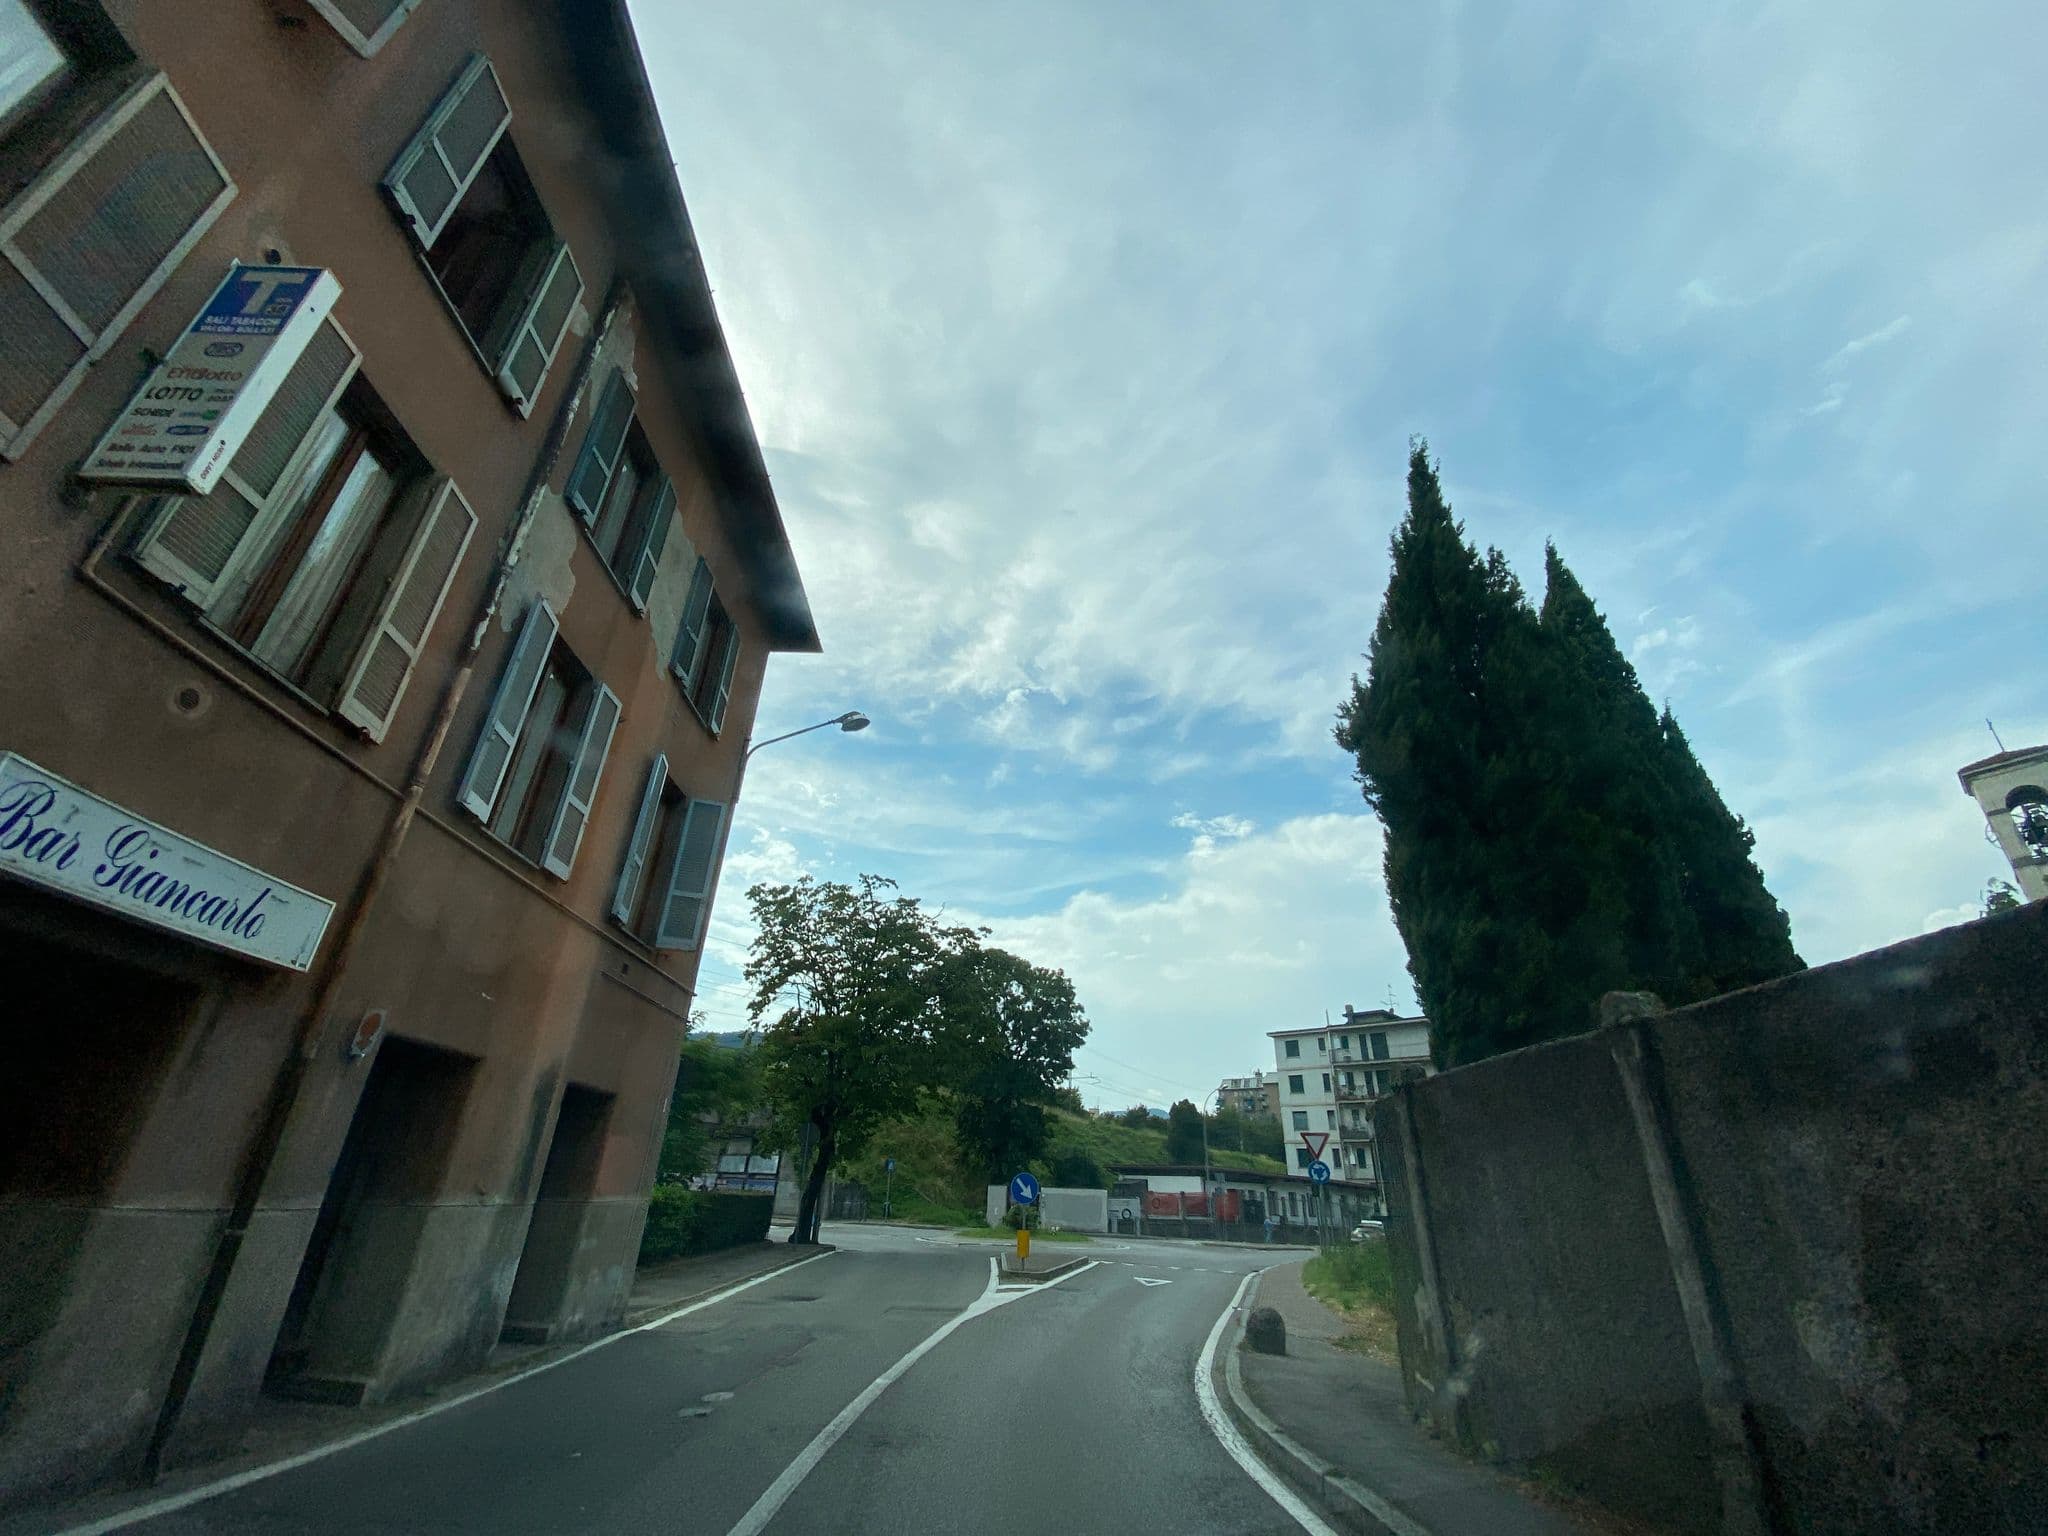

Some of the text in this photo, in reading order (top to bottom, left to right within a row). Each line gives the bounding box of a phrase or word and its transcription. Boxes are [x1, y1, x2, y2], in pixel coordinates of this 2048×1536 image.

[240, 271, 308, 315] T
[145, 387, 203, 400] LOTTO
[0, 781, 272, 939] Bar Giancarlo
